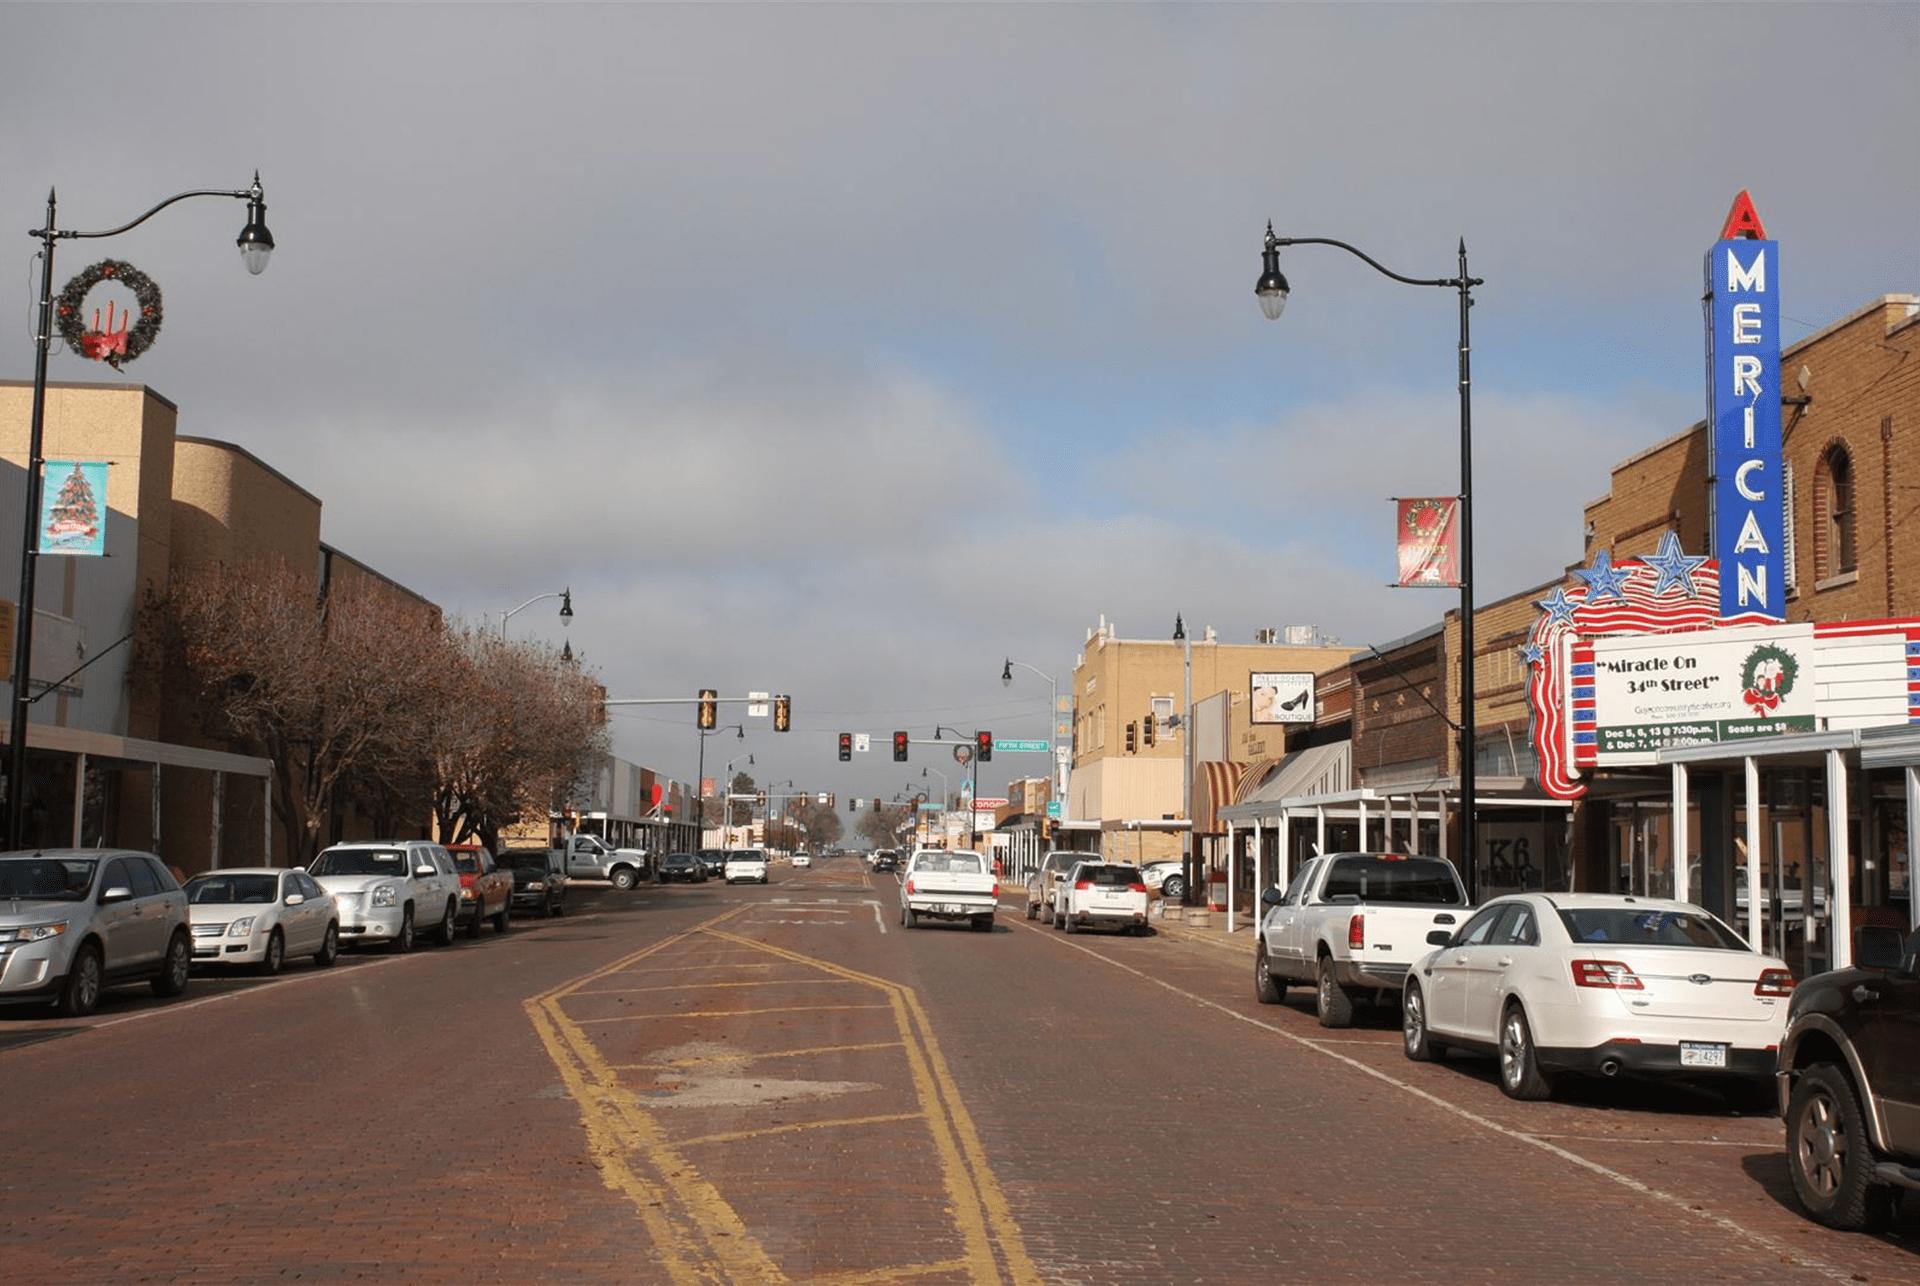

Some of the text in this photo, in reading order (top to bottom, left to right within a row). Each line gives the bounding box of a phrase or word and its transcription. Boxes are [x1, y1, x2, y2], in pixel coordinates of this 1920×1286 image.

[1719, 188, 1769, 609] AMERICAN
[1673, 656, 1697, 669] On
[1627, 680, 1658, 694] 34th
[1275, 713, 1312, 721] BOUTIQUE
[1605, 730, 1624, 738] Dec
[1626, 728, 1636, 738] 5,
[1649, 727, 1661, 736] 13
[1663, 726, 1671, 736] @
[1672, 725, 1713, 735] 7:30p.m.
[1728, 725, 1755, 734] Seats
[1757, 724, 1773, 732] are
[1606, 742, 1614, 750] &
[1616, 740, 1635, 749] Dec
[1649, 739, 1661, 748] 14
[1663, 738, 1671, 747] @
[1485, 837, 1530, 871] K6
